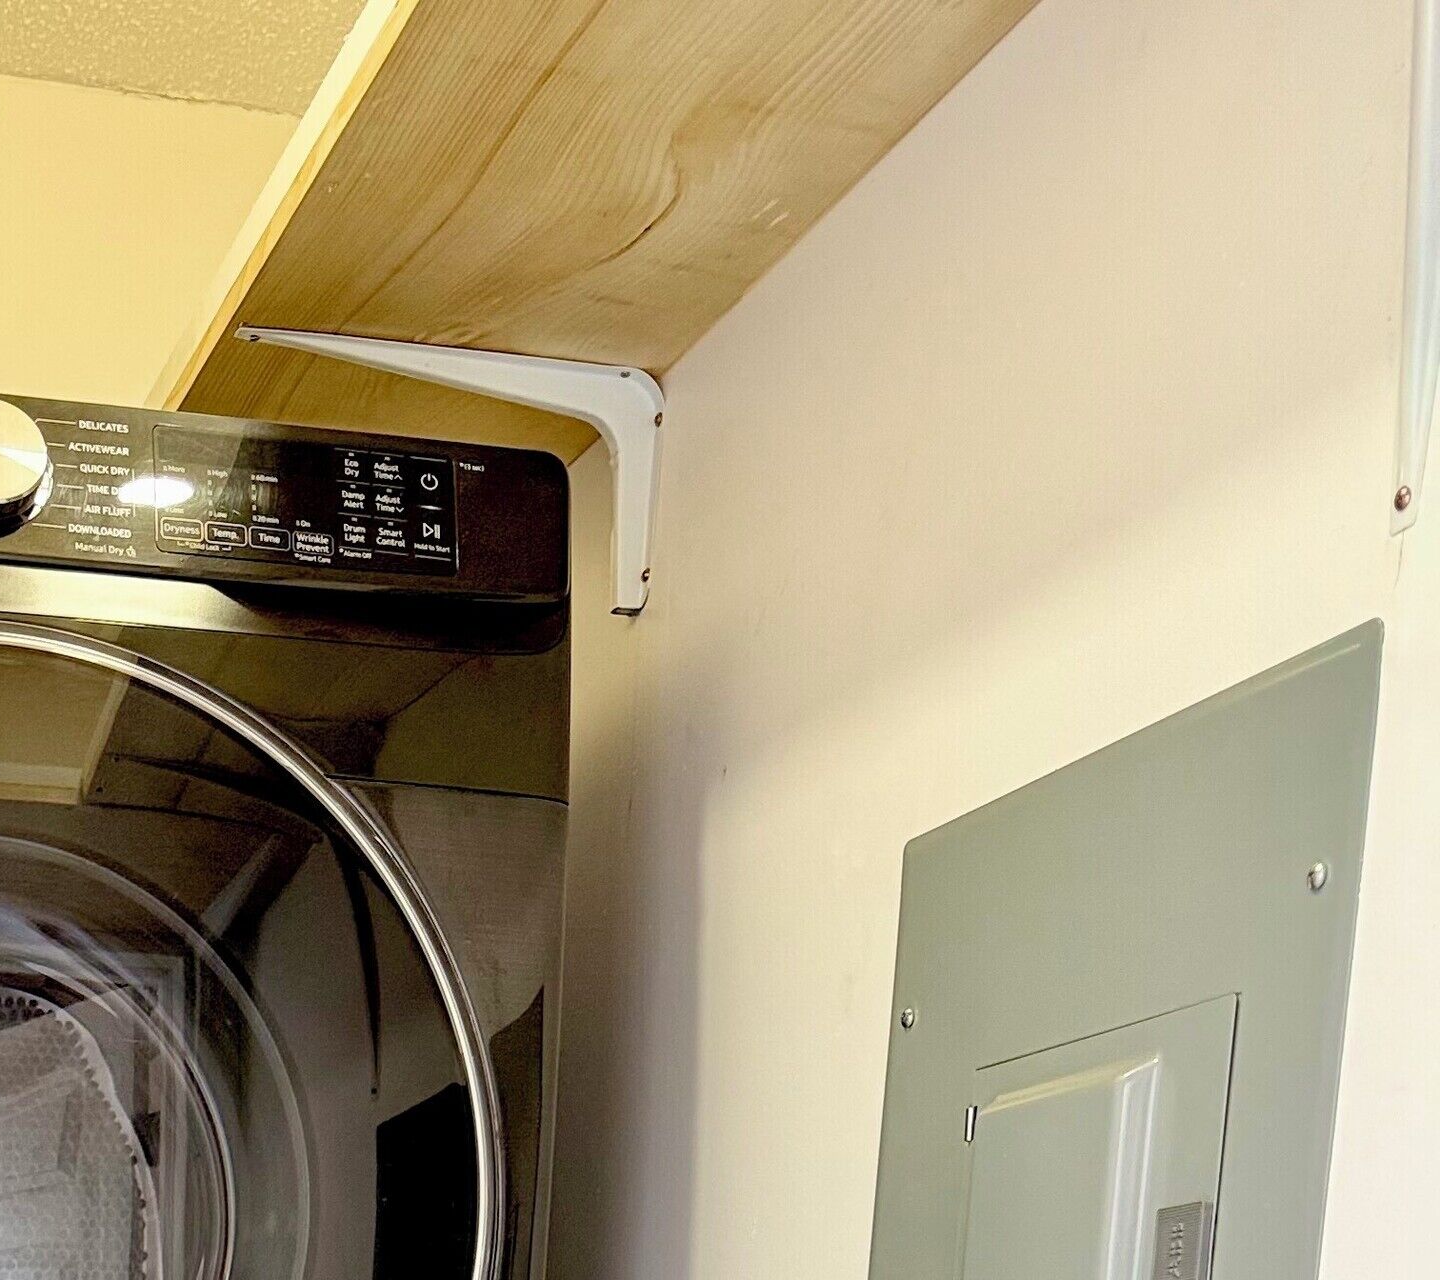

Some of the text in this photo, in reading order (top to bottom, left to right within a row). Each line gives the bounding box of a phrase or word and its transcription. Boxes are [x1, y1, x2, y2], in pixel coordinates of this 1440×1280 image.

[79, 420, 129, 433] DELICATES
[68, 442, 130, 456] ACTIVEWEAR
[344, 459, 359, 468] Eco
[373, 462, 399, 473] Adjust
[80, 463, 130, 476] QUICK DRY
[344, 467, 359, 477] Dry
[374, 471, 393, 480] Time
[86, 484, 111, 495] TIME
[341, 490, 365, 500] Damp
[343, 500, 364, 509] Alert
[375, 494, 400, 504] Adjust
[84, 505, 131, 517] AIR FLUFF
[375, 502, 395, 512] Time
[68, 523, 132, 538] DOWNLOADED
[163, 523, 200, 537] Dryness
[343, 524, 366, 533] Drum
[378, 527, 403, 538] Smart
[211, 528, 240, 541] Temp.
[258, 533, 281, 544] Time
[296, 533, 329, 545] Wrinkle
[344, 533, 365, 544] Light
[296, 542, 330, 553] Prevent
[376, 537, 405, 548] Control
[75, 542, 125, 556] Manual Dry
